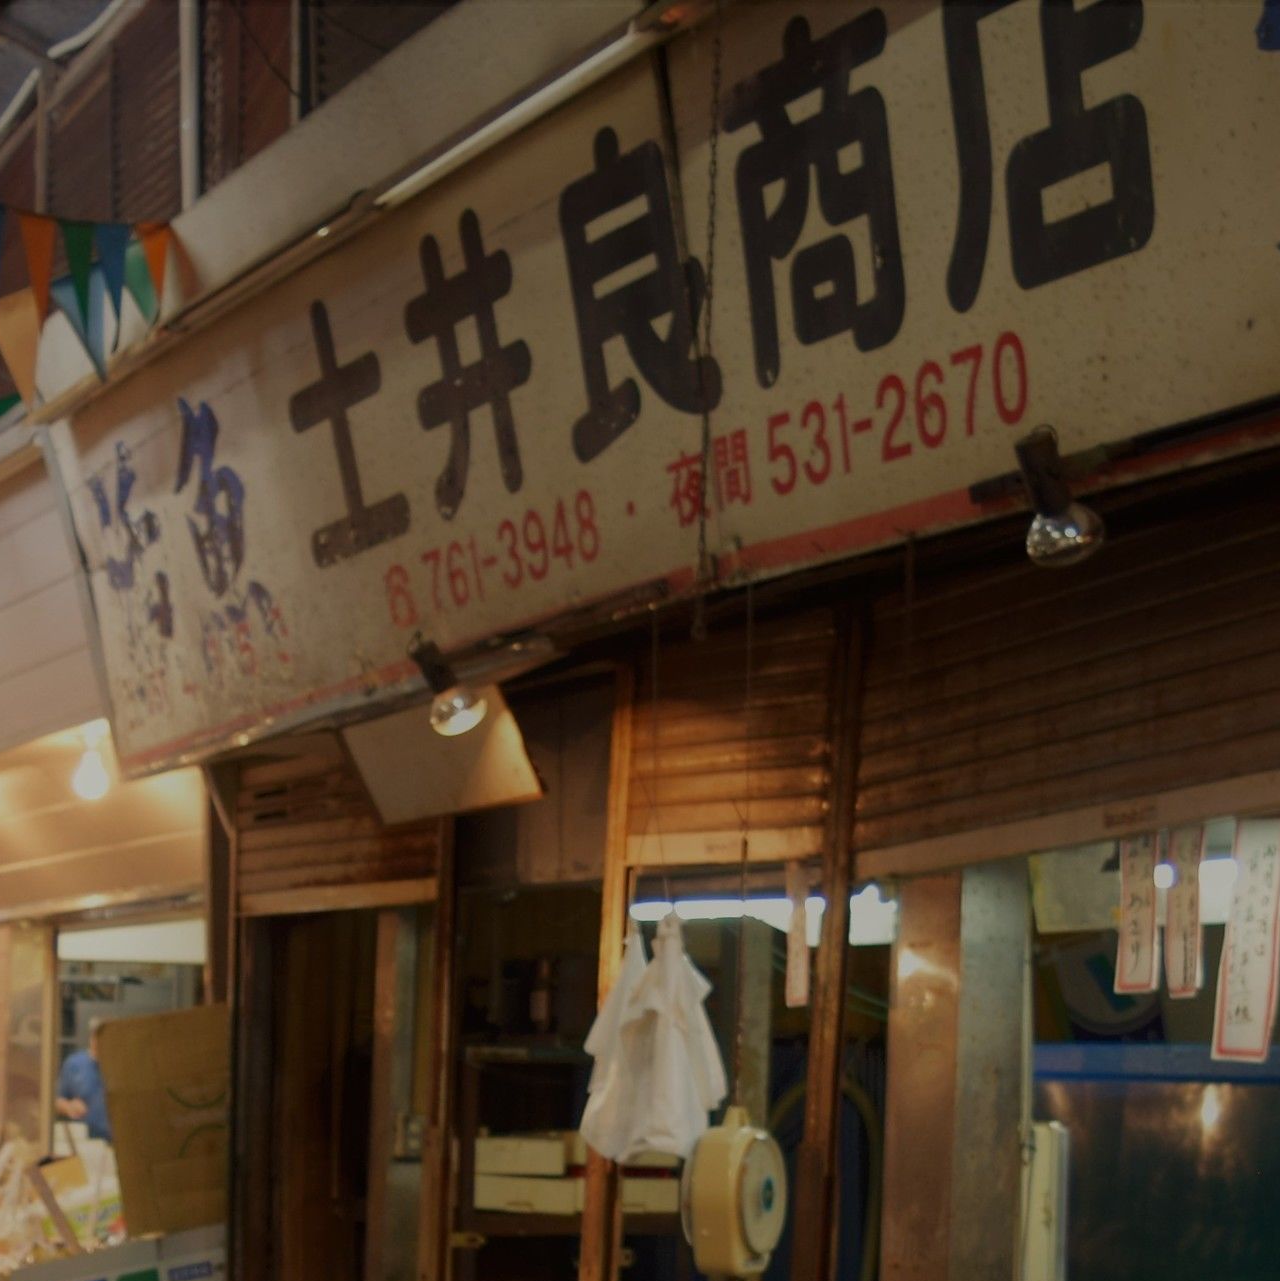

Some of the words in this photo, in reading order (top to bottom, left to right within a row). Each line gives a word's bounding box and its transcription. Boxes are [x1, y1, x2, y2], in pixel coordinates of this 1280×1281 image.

[290, 0, 1157, 563] 土井良商店
[422, 490, 601, 614] 761-3948
[666, 428, 754, 528] 夜間
[767, 330, 1030, 496] 531-2670
